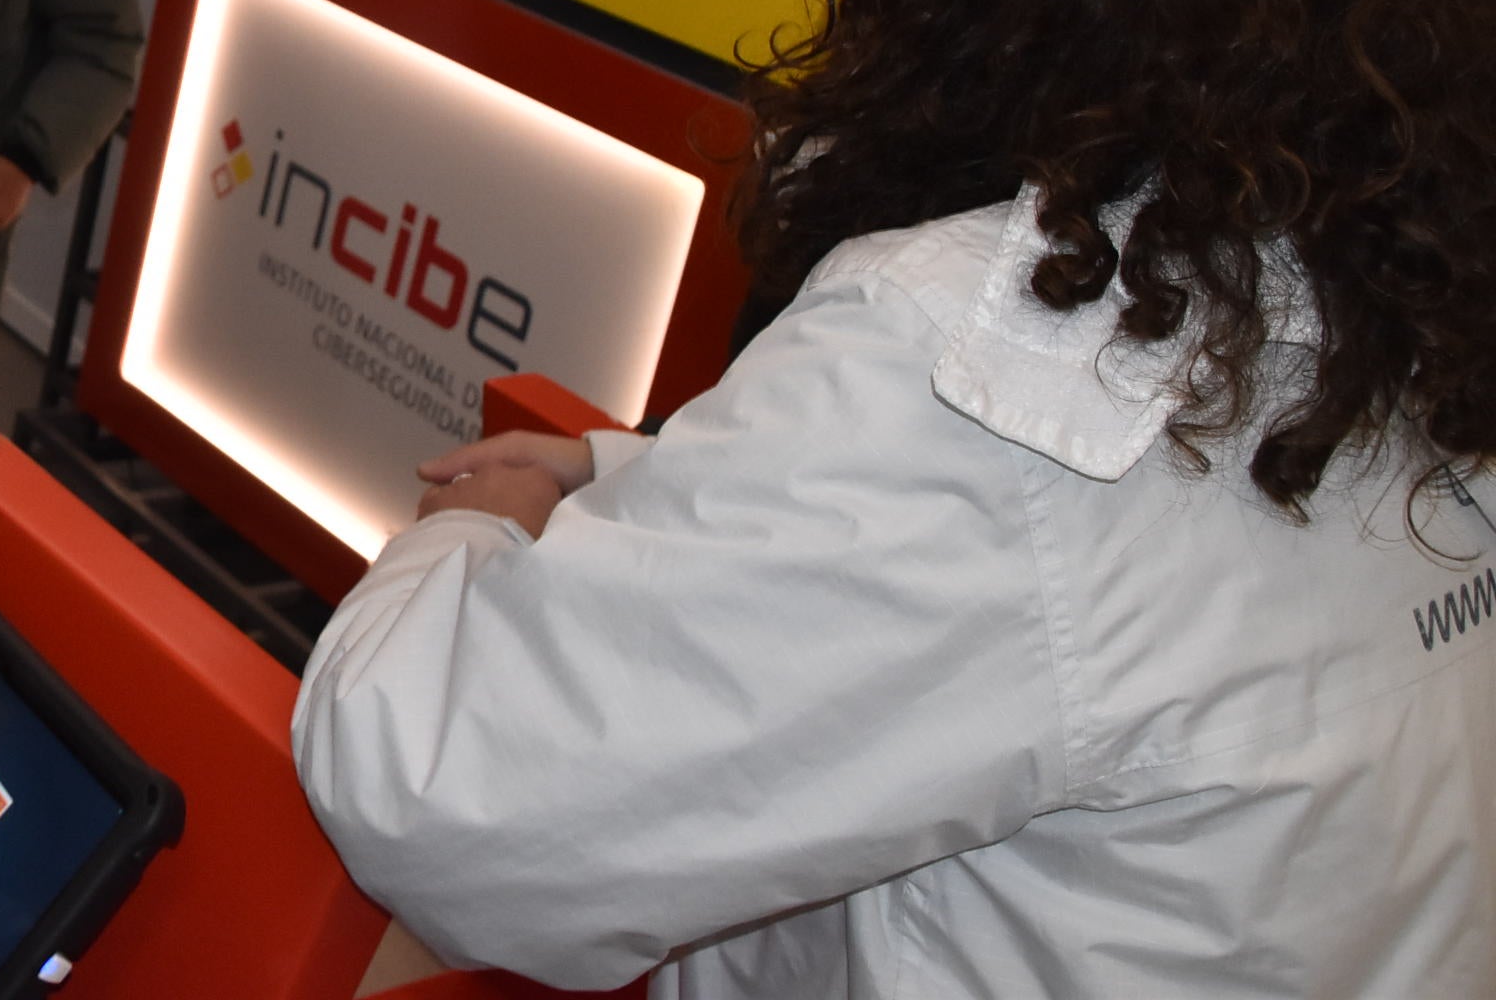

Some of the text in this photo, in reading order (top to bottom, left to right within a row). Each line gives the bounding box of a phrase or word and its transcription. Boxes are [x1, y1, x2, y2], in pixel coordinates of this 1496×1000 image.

[257, 252, 353, 328] INSTITUTO
[356, 312, 455, 398] NACIONAL
[258, 128, 534, 373] incibe
